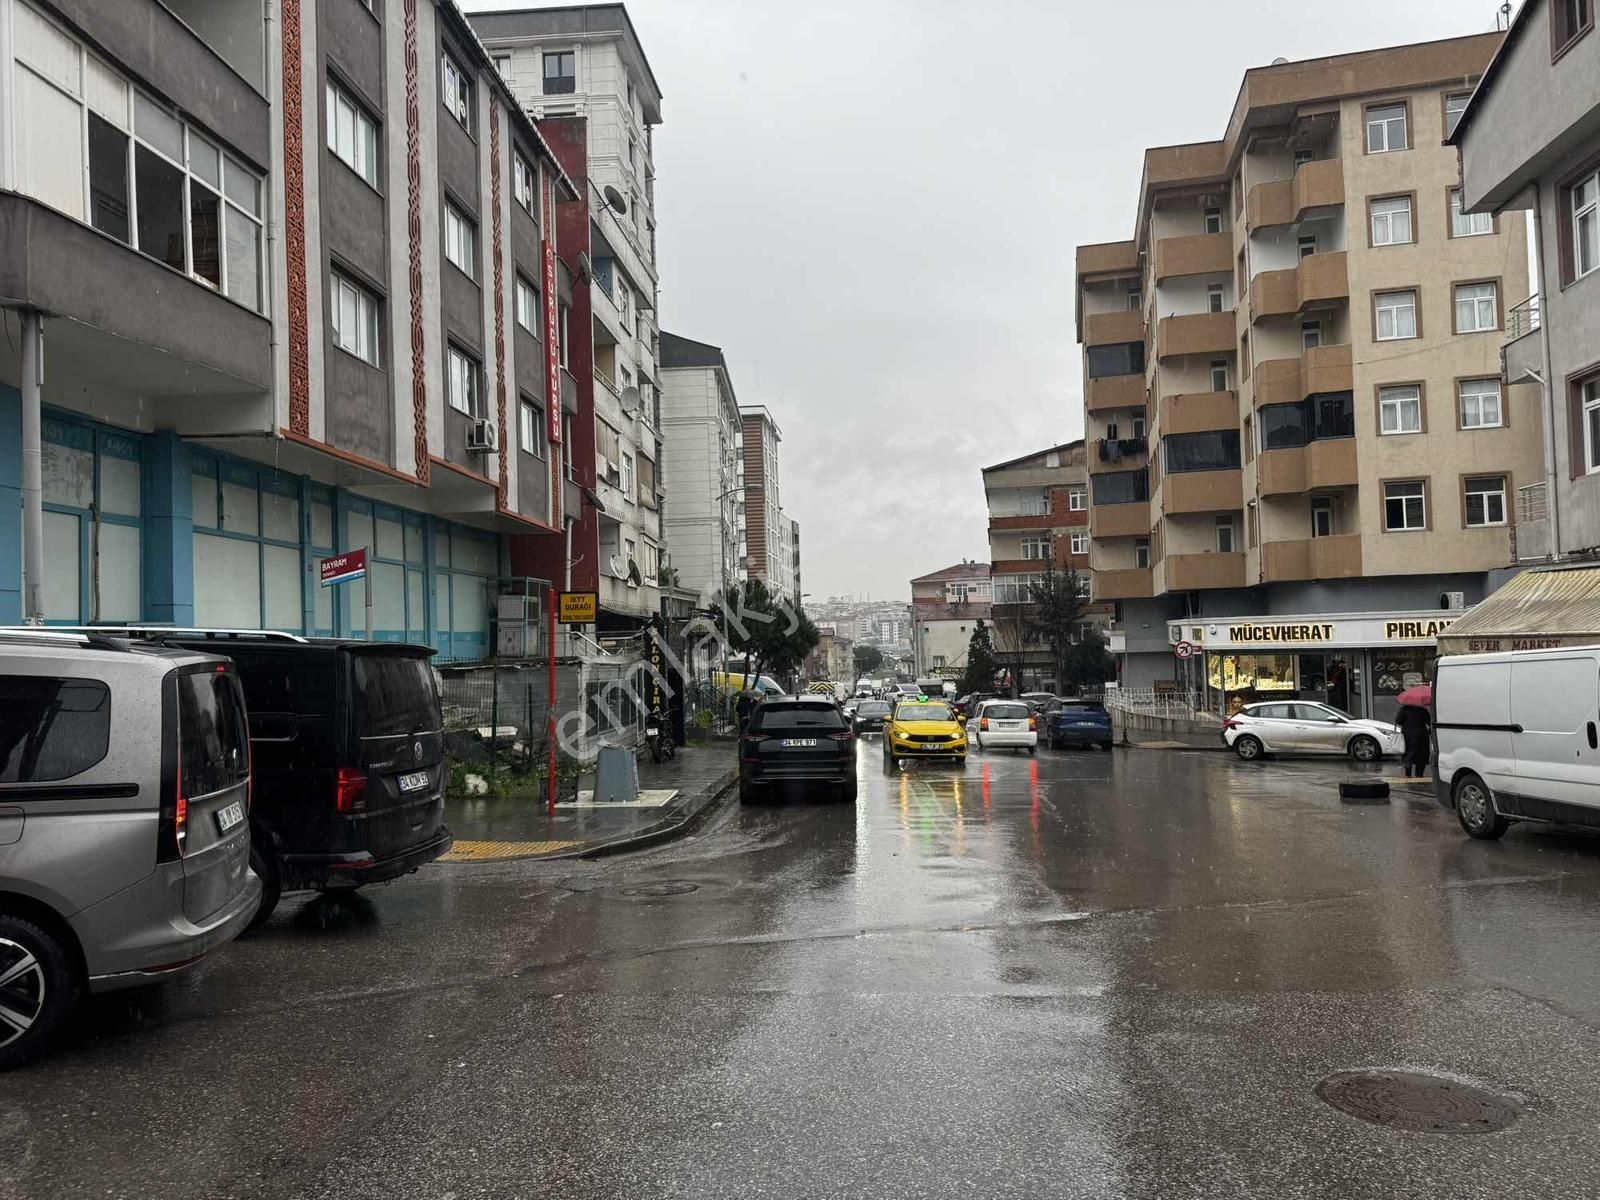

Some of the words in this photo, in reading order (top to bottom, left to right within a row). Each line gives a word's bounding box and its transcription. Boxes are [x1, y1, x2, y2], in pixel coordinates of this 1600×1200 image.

[551, 364, 559, 437] KURSU
[322, 557, 347, 572] BAYRAM
[565, 602, 592, 610] DURAĞI
[1229, 622, 1333, 642] MÜCEVHERAT
[650, 628, 660, 673] SALON
[1468, 640, 1500, 651] SEVER
[1512, 639, 1561, 651] MARKET
